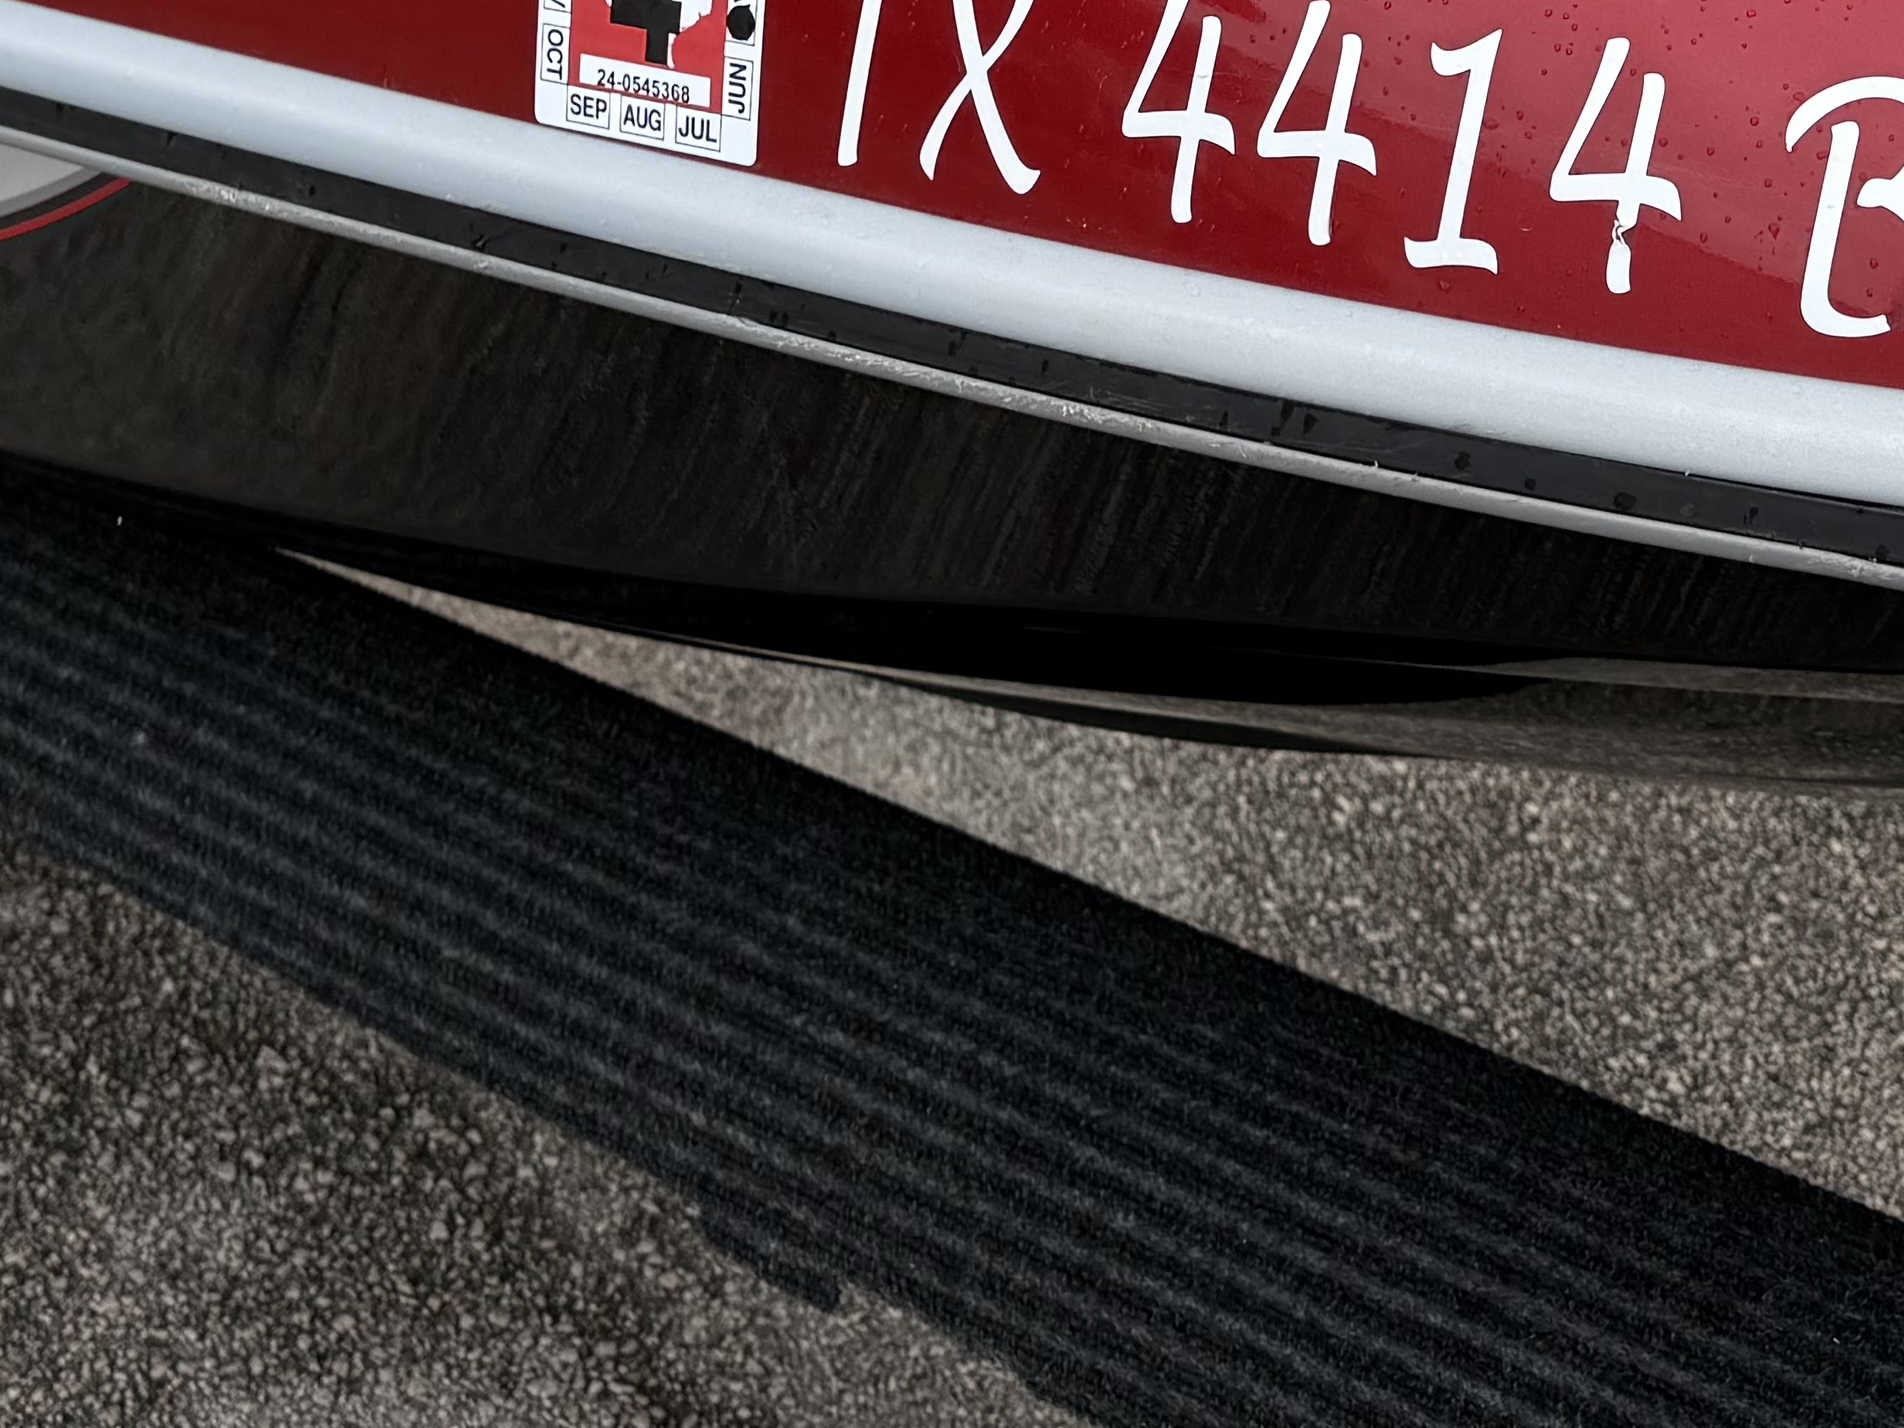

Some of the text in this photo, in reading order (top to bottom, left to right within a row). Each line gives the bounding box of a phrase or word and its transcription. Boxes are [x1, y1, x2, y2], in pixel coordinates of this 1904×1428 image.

[546, 29, 564, 80] OCT
[596, 68, 691, 105] 24-0545368
[728, 62, 748, 114] JUN
[569, 93, 718, 144] SEP AUG JUL
